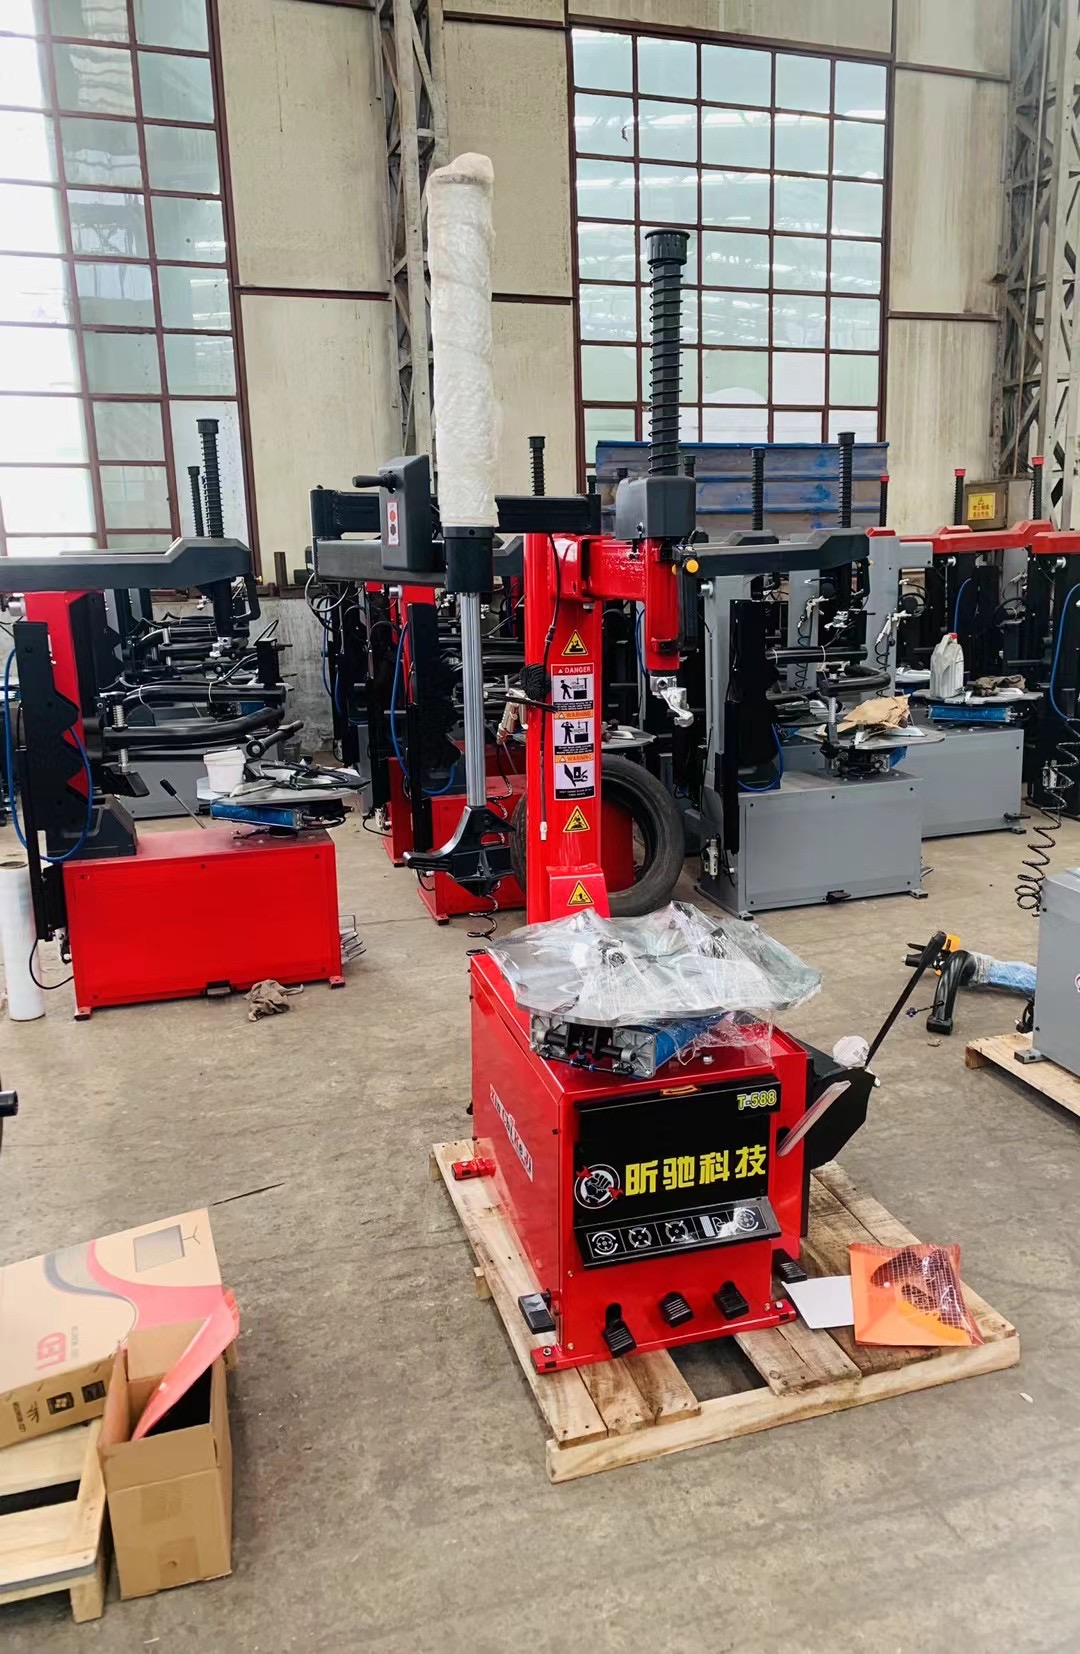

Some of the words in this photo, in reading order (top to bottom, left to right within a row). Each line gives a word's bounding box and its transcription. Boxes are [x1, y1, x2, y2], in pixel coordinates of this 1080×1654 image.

[564, 666, 591, 674] DANGER
[737, 1089, 777, 1110] T-588
[625, 1144, 767, 1197] 昕驰科技
